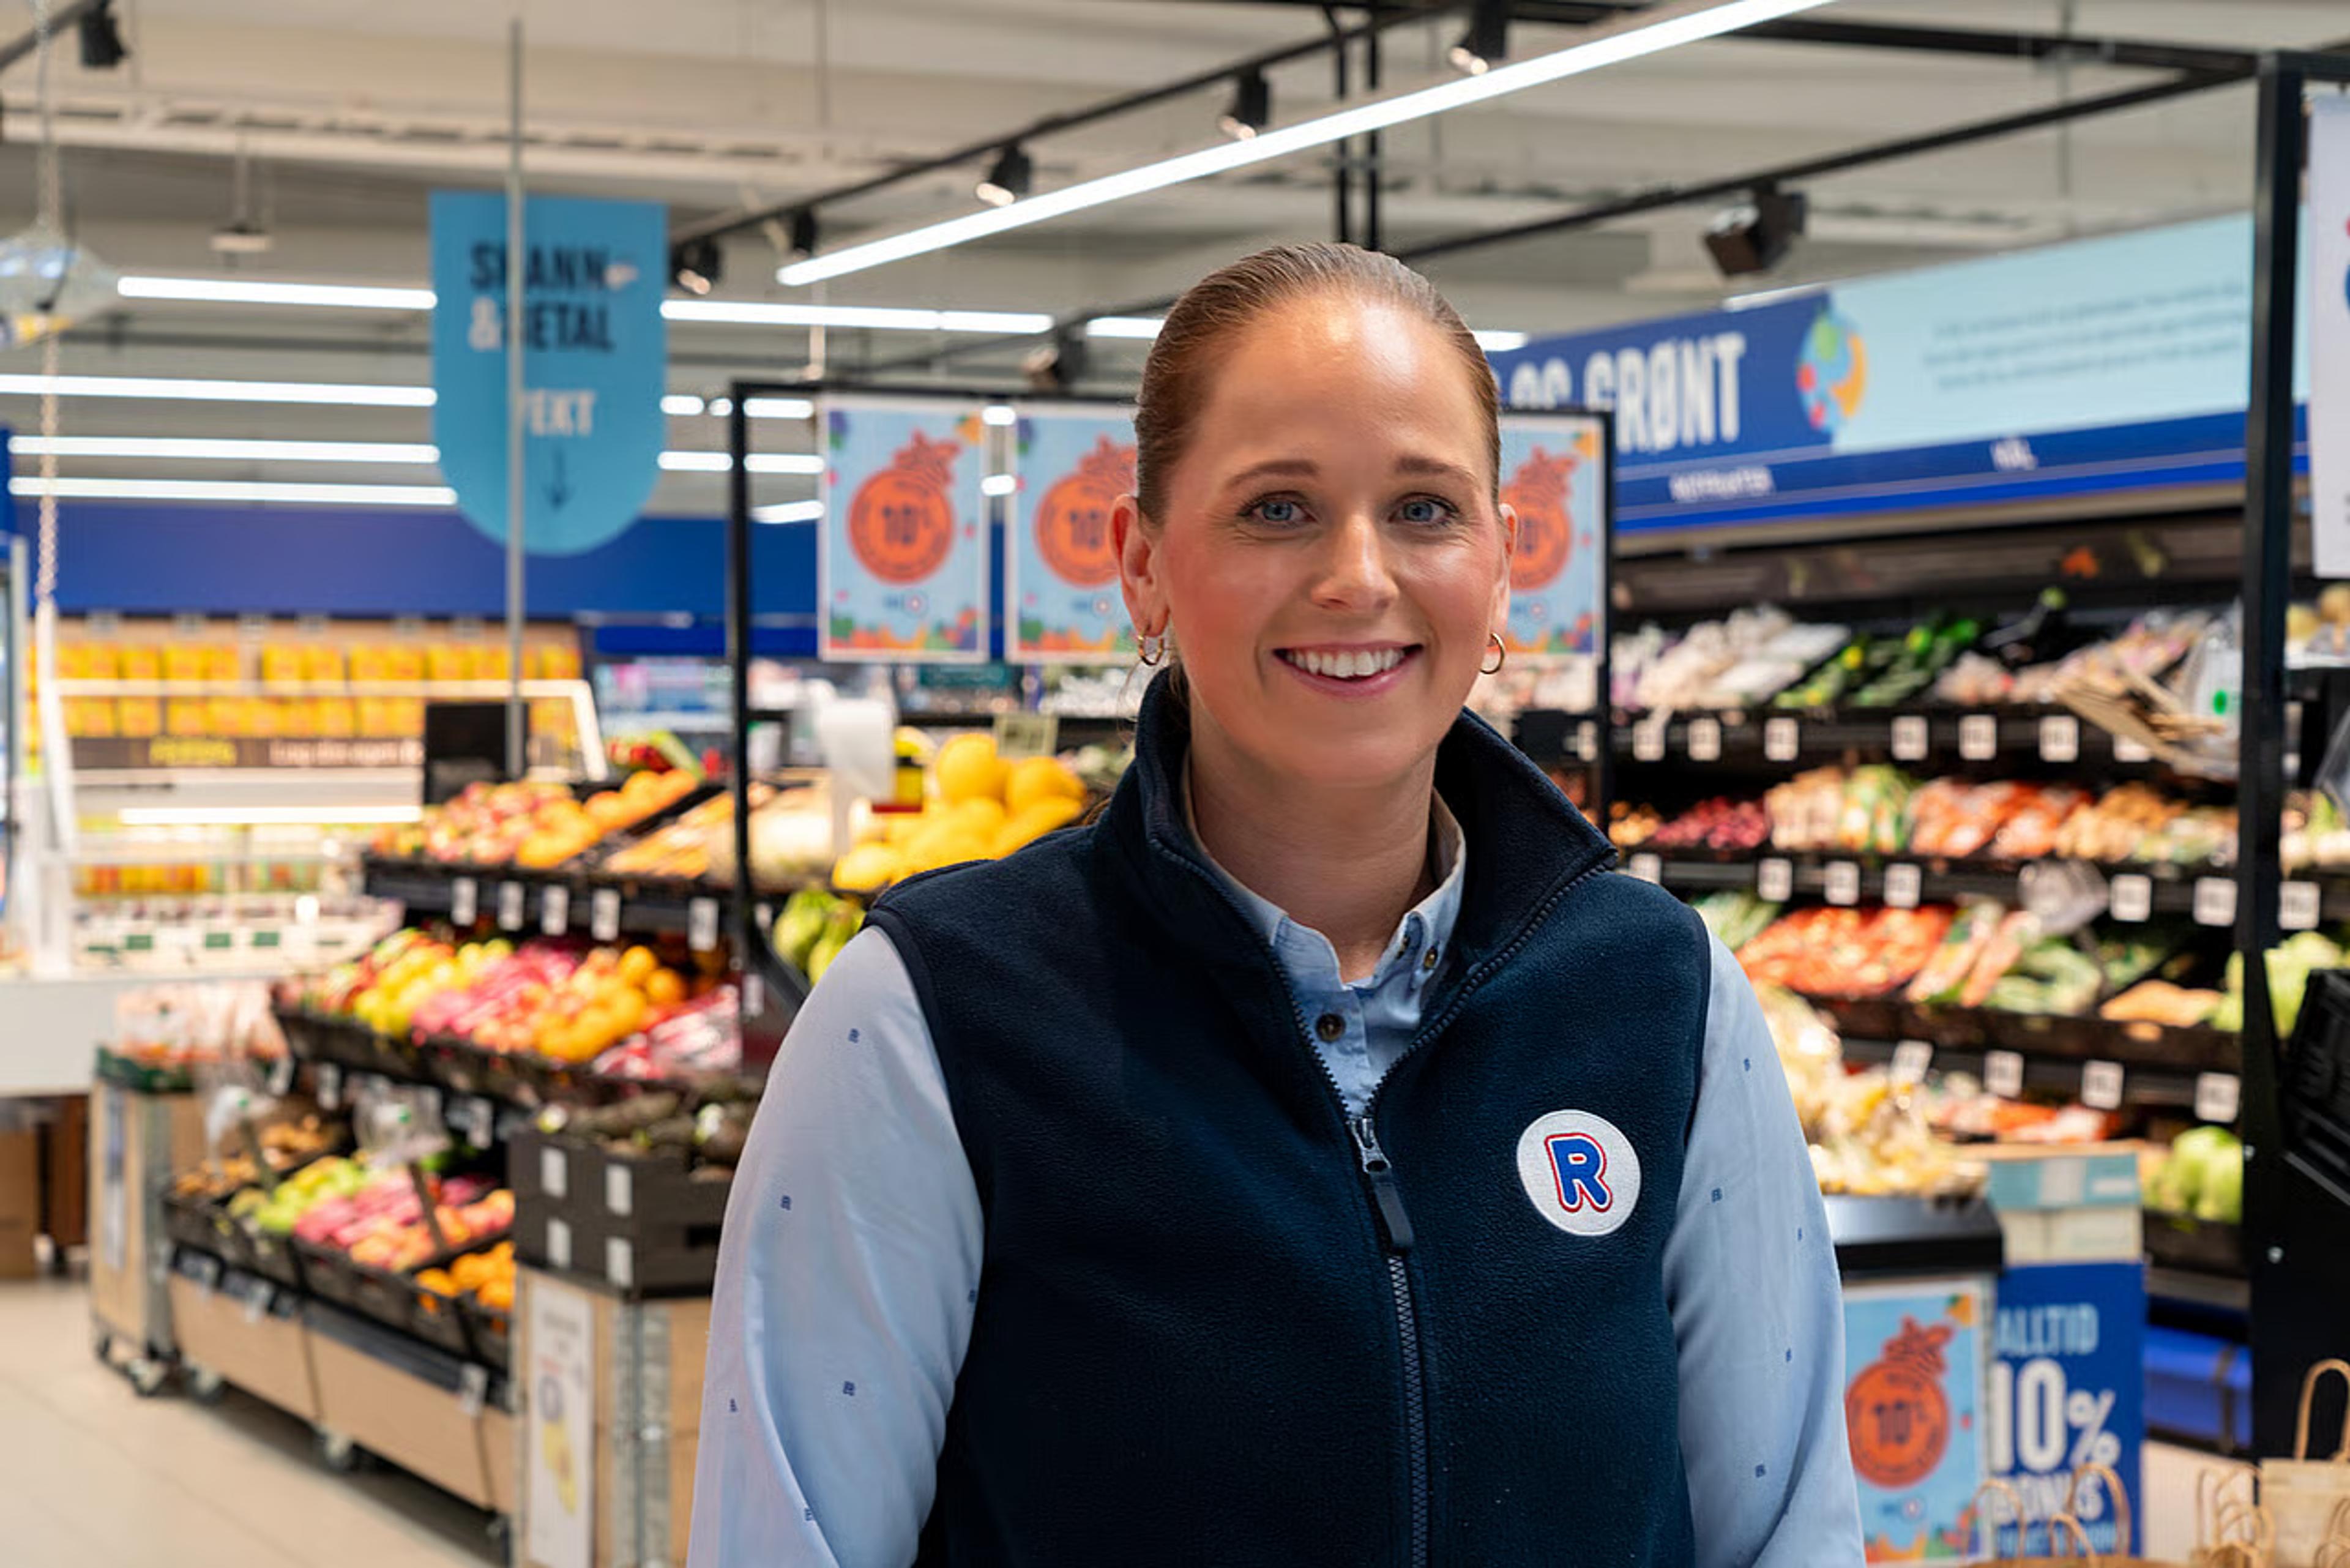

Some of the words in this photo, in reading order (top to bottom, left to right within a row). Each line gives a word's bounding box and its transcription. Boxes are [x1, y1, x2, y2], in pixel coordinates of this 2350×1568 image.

[470, 242, 608, 292] SANN
[504, 301, 615, 353] ETAL
[1543, 1132, 1613, 1213] R
[1990, 1357, 2121, 1471] 10%
